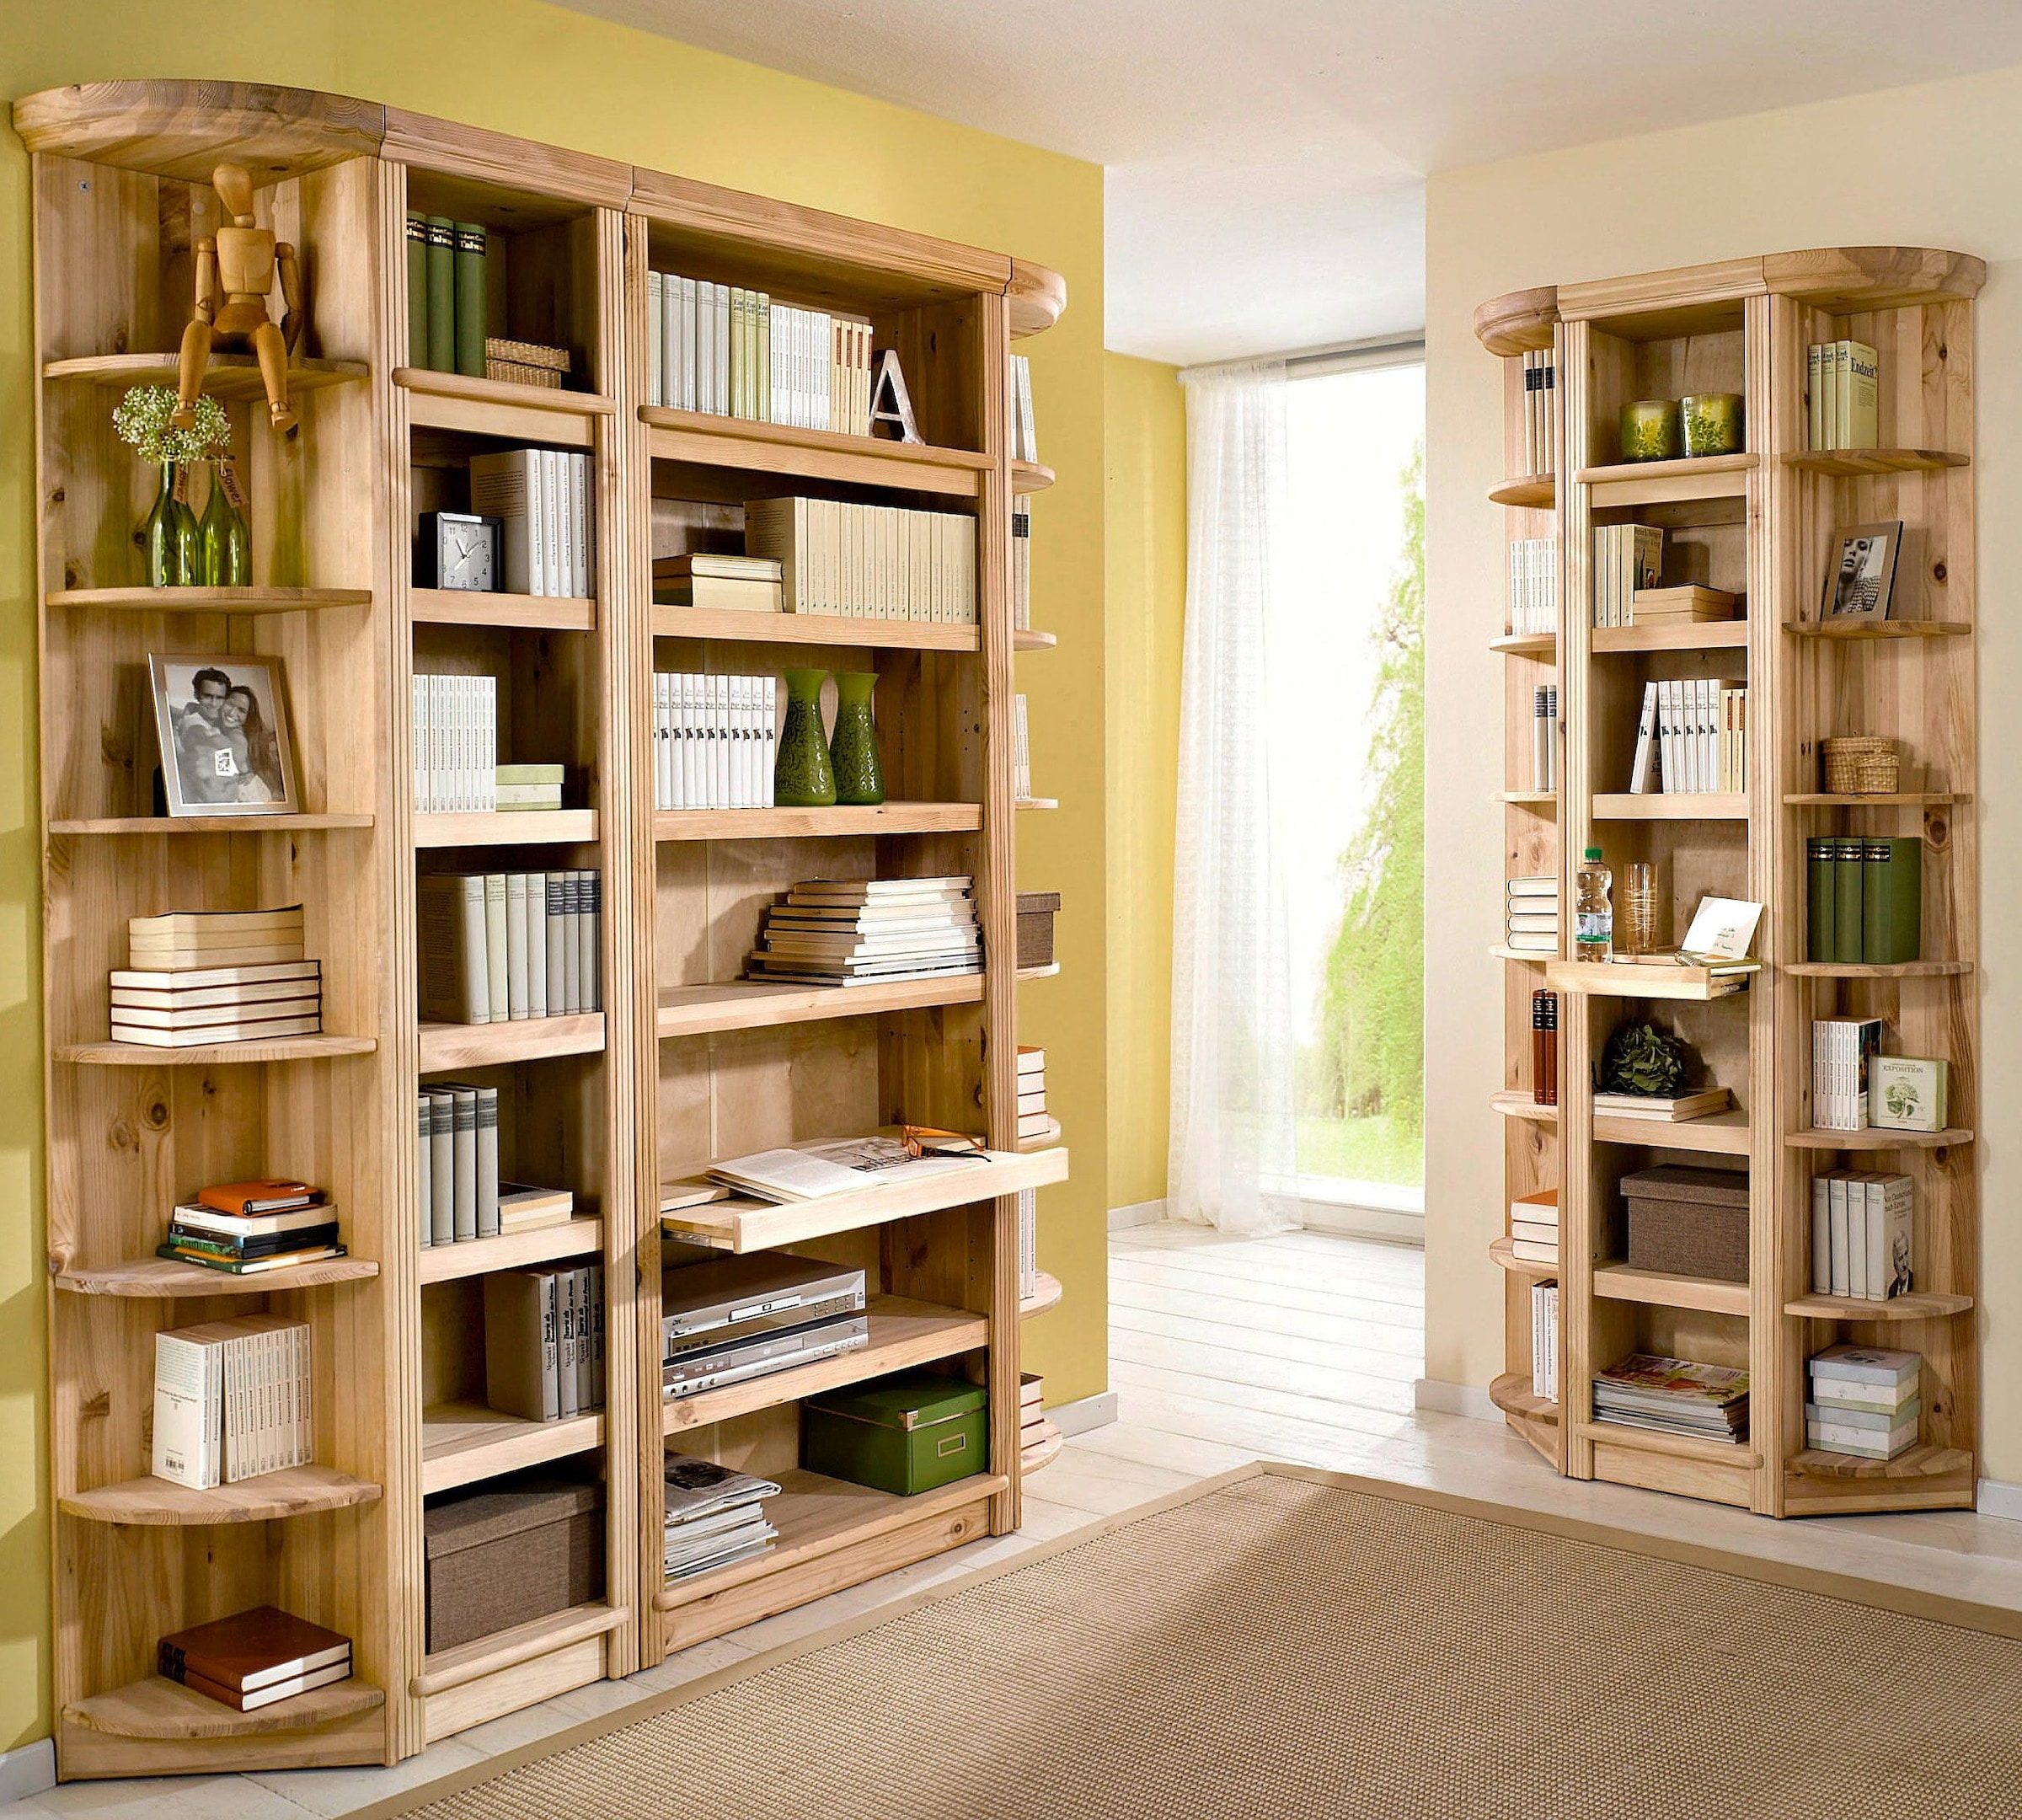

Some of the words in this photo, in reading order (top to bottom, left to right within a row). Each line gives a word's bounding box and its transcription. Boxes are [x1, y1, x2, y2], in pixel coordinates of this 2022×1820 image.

[869, 349, 926, 445] A
[481, 539, 487, 549] 2
[485, 553, 490, 563] 3
[450, 575, 456, 584] 7
[473, 576, 479, 586] 5
[1883, 1065, 1923, 1073] EXPOSITION
